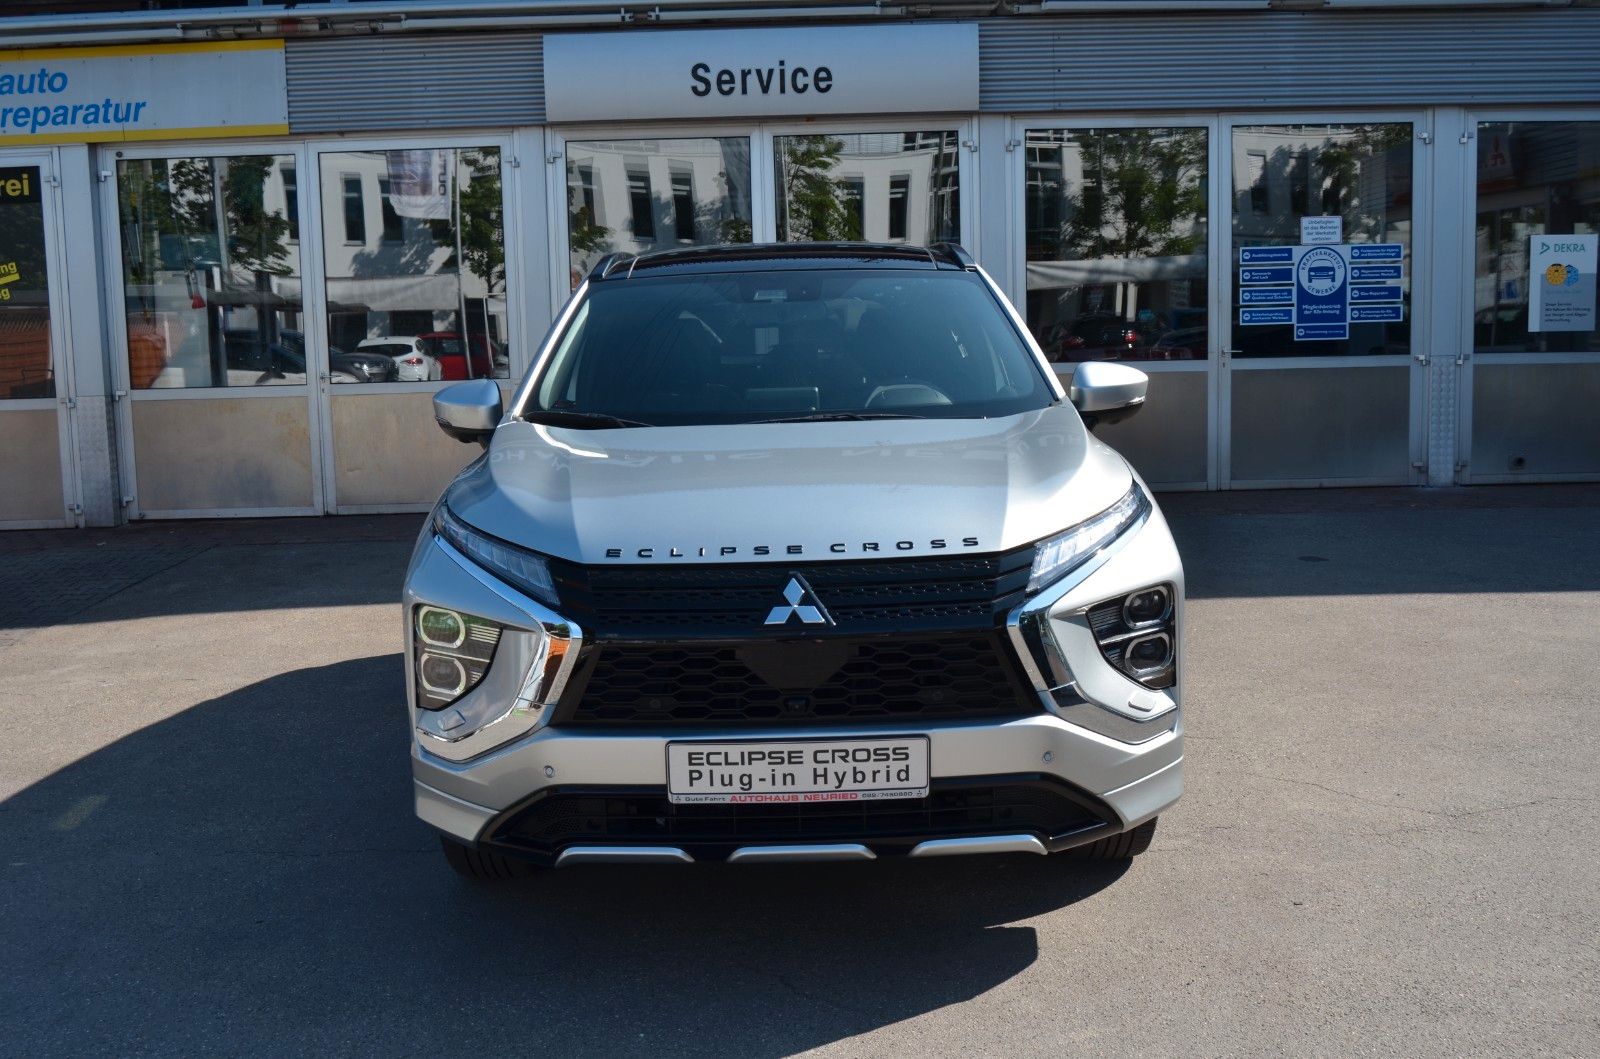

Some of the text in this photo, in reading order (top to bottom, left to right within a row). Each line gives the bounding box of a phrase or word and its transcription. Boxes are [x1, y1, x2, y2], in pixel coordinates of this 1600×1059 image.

[0, 68, 68, 95] auto
[690, 59, 833, 97] Service
[0, 98, 146, 133] reparatur
[1553, 243, 1586, 253] DEKRA
[605, 537, 979, 559] ECLIPSE CROSS
[687, 747, 910, 767] ECLIPSE CROSS
[689, 764, 911, 792] Plug-in Hybrid
[729, 794, 799, 803] AUTOHAUS
[803, 792, 858, 801] NEURIED
